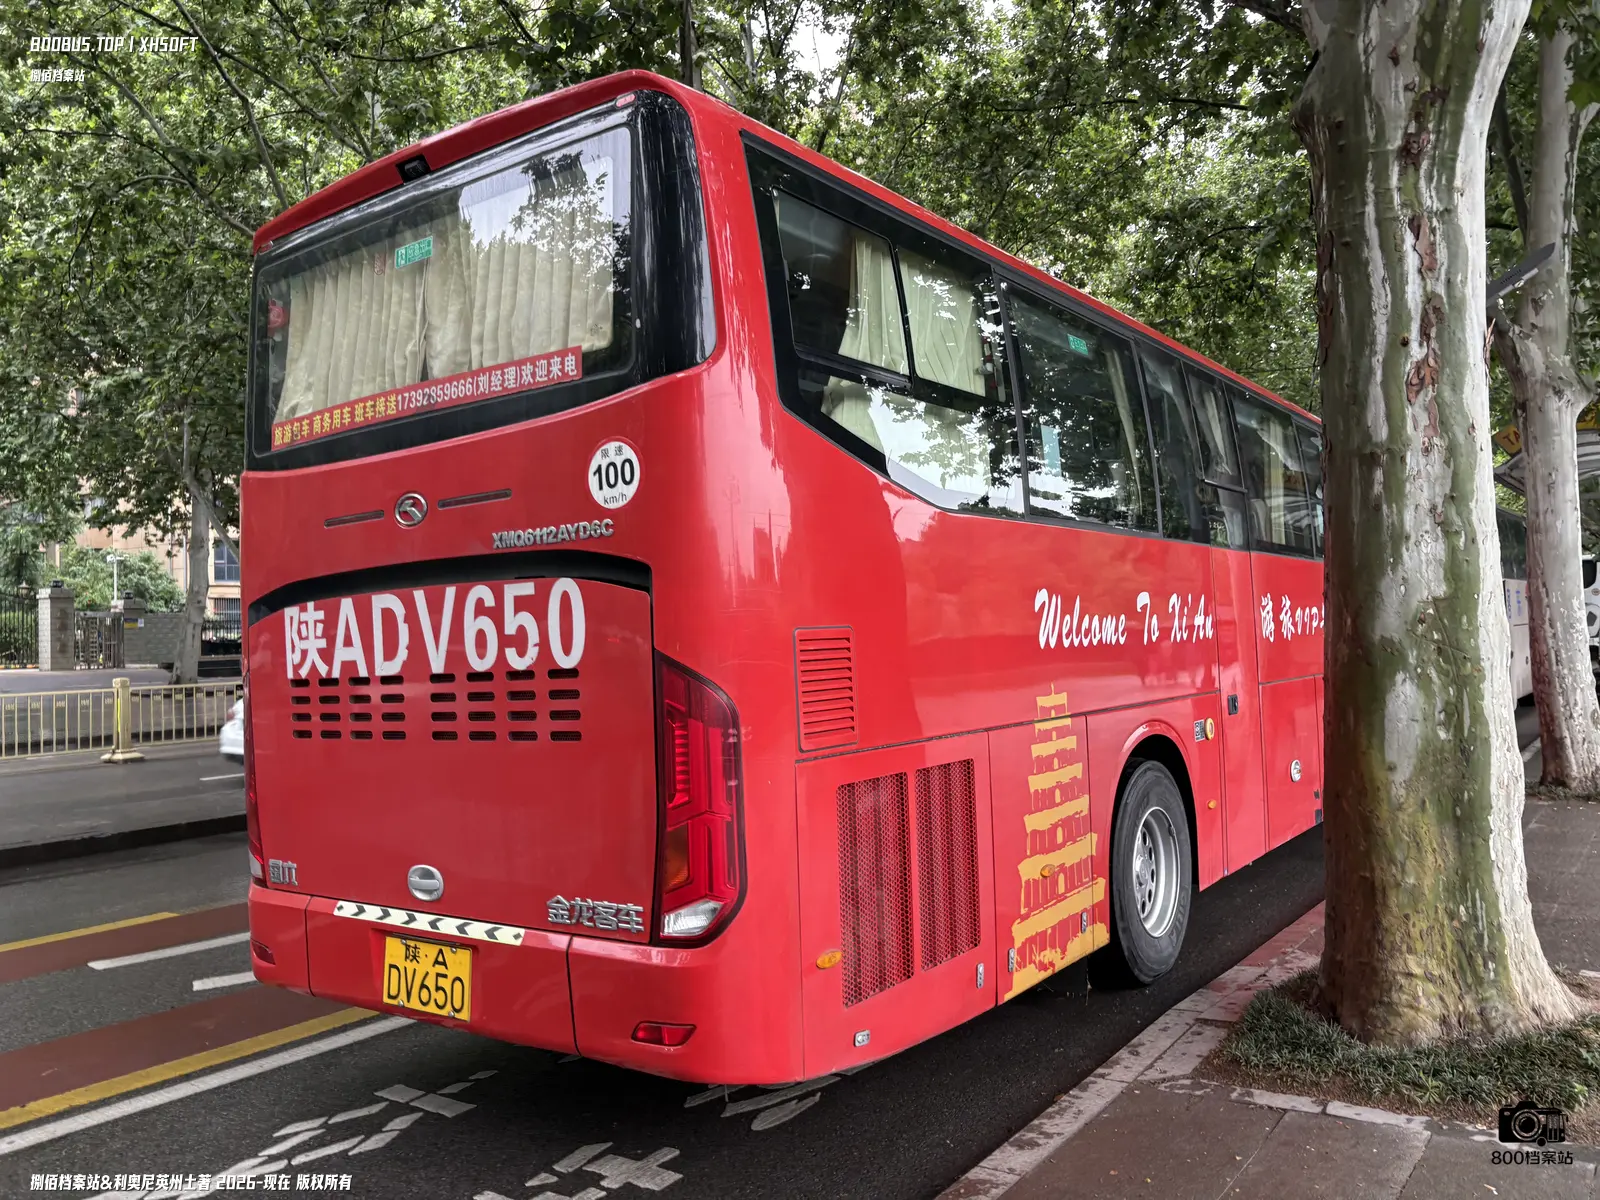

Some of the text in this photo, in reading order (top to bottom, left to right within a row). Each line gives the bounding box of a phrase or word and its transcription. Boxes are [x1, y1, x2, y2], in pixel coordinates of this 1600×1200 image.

[274, 418, 310, 446] 旅游包车
[313, 407, 351, 435] 商务用车
[600, 444, 624, 460] 限速
[593, 458, 635, 491] 100
[603, 492, 627, 505] km/h
[492, 518, 615, 549] XMQ6112AYD6C
[284, 577, 586, 680] 陕ADV650
[1034, 588, 1214, 650] Welcome To Xi'An
[546, 895, 644, 934] 金龙客车
[386, 963, 466, 1015] DV650
